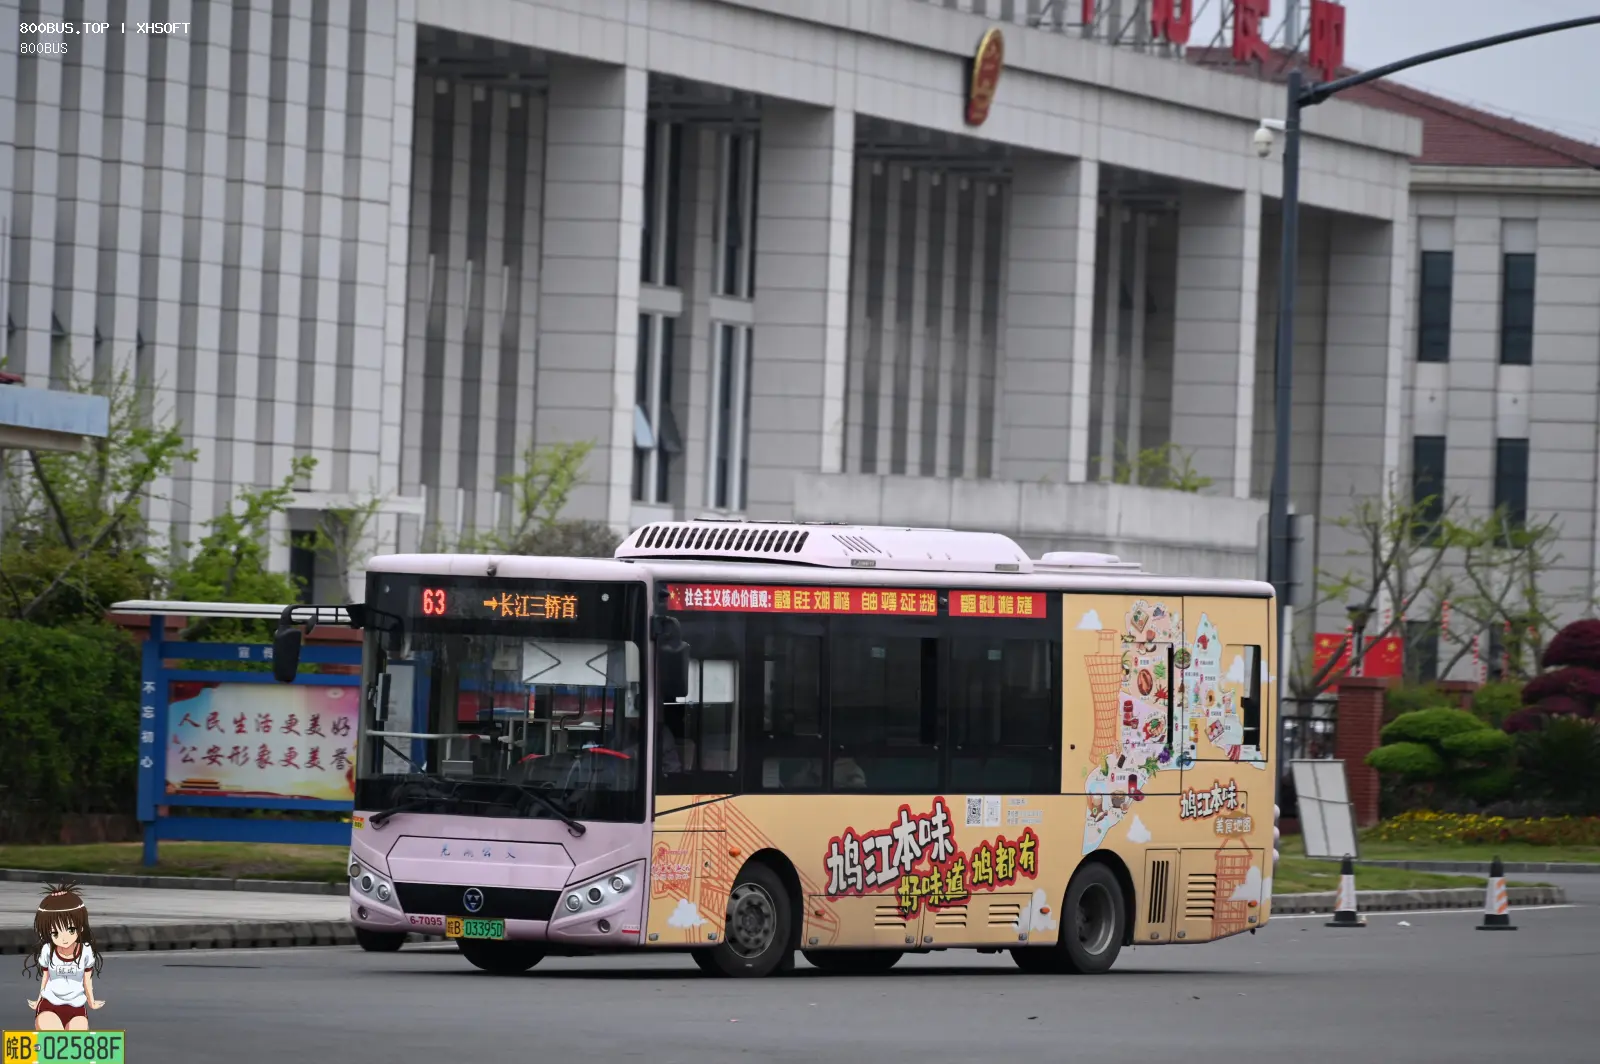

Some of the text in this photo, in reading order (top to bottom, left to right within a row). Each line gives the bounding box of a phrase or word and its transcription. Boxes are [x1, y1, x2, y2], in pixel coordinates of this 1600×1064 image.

[422, 588, 445, 615] 63
[499, 592, 578, 619] 长江三桥首
[793, 590, 810, 610] 民主
[813, 591, 831, 610] 文明
[861, 592, 878, 611] 自由
[900, 593, 917, 612] 公正
[919, 593, 936, 612] 法治
[1016, 596, 1033, 615] 友善
[140, 682, 156, 769] 不忘初心
[178, 711, 352, 738] 人民生活更美好
[178, 743, 352, 771] 公安形象更美誉
[1180, 780, 1238, 819] 鸠江本味
[1215, 816, 1252, 834] 美食地图
[826, 801, 955, 895] 鸠江本味
[898, 832, 1037, 916] 好味道 鸠都有
[409, 915, 443, 926] 6-7095
[465, 921, 503, 937] 03395D
